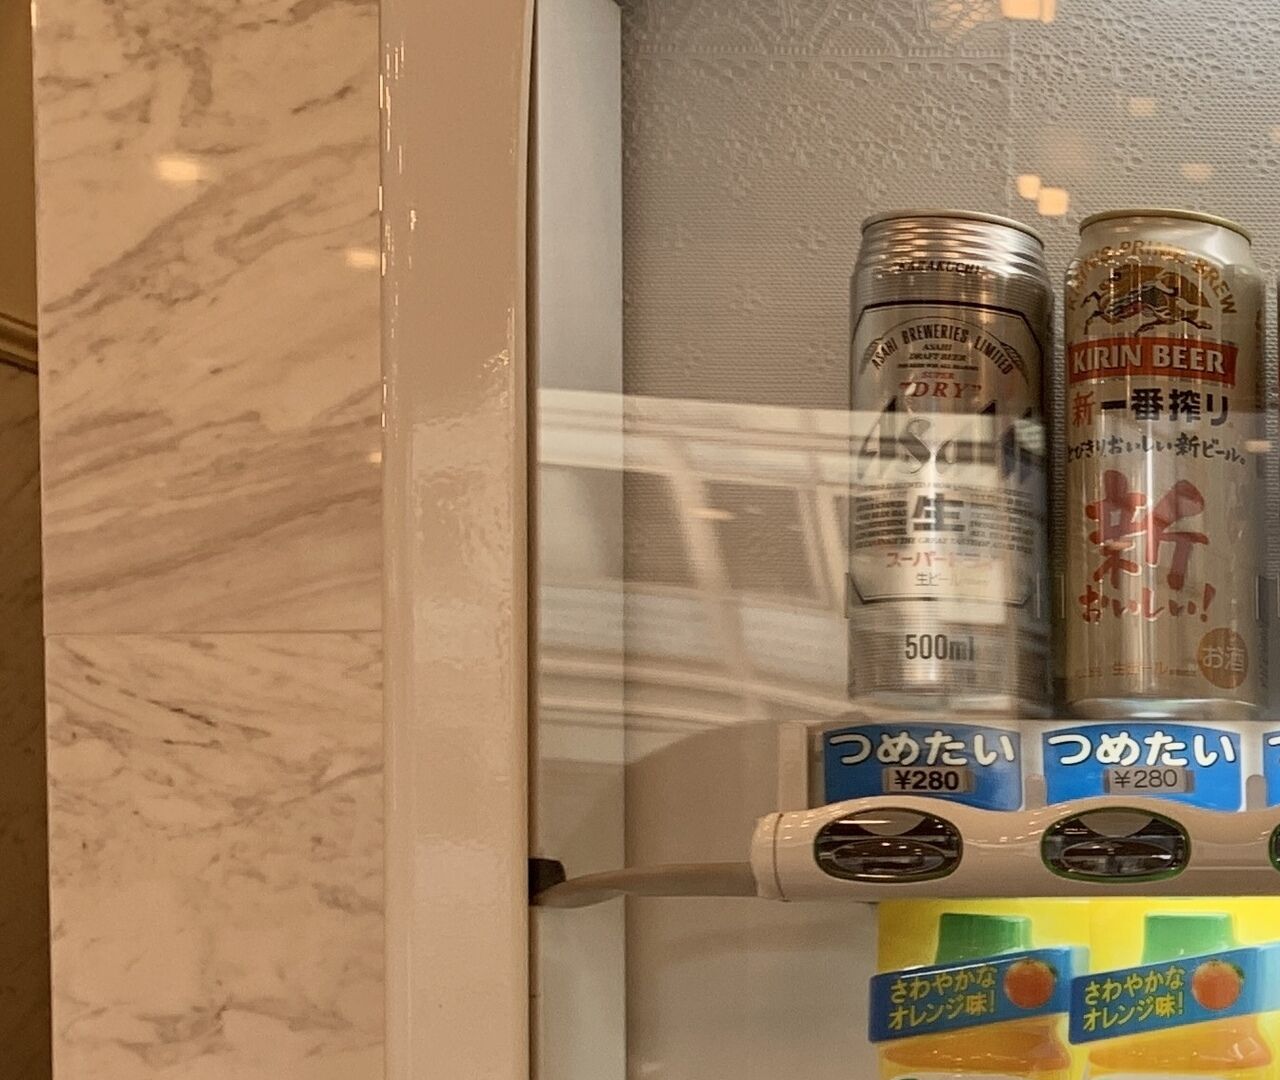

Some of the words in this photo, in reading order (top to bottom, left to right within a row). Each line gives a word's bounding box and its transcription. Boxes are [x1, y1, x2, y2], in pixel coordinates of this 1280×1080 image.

[1073, 345, 1142, 375] KIRIN
[1152, 345, 1226, 375] BEER
[905, 634, 975, 661] 500ml
[829, 731, 1016, 766] つめたい
[893, 769, 961, 792] ¥280
[1113, 768, 1179, 789] ¥280
[889, 964, 999, 1006] さわやかな
[1082, 965, 1187, 1006] さわやかな
[888, 998, 997, 1032] オレンジ味!
[1082, 999, 1187, 1033] オレンジ味!
